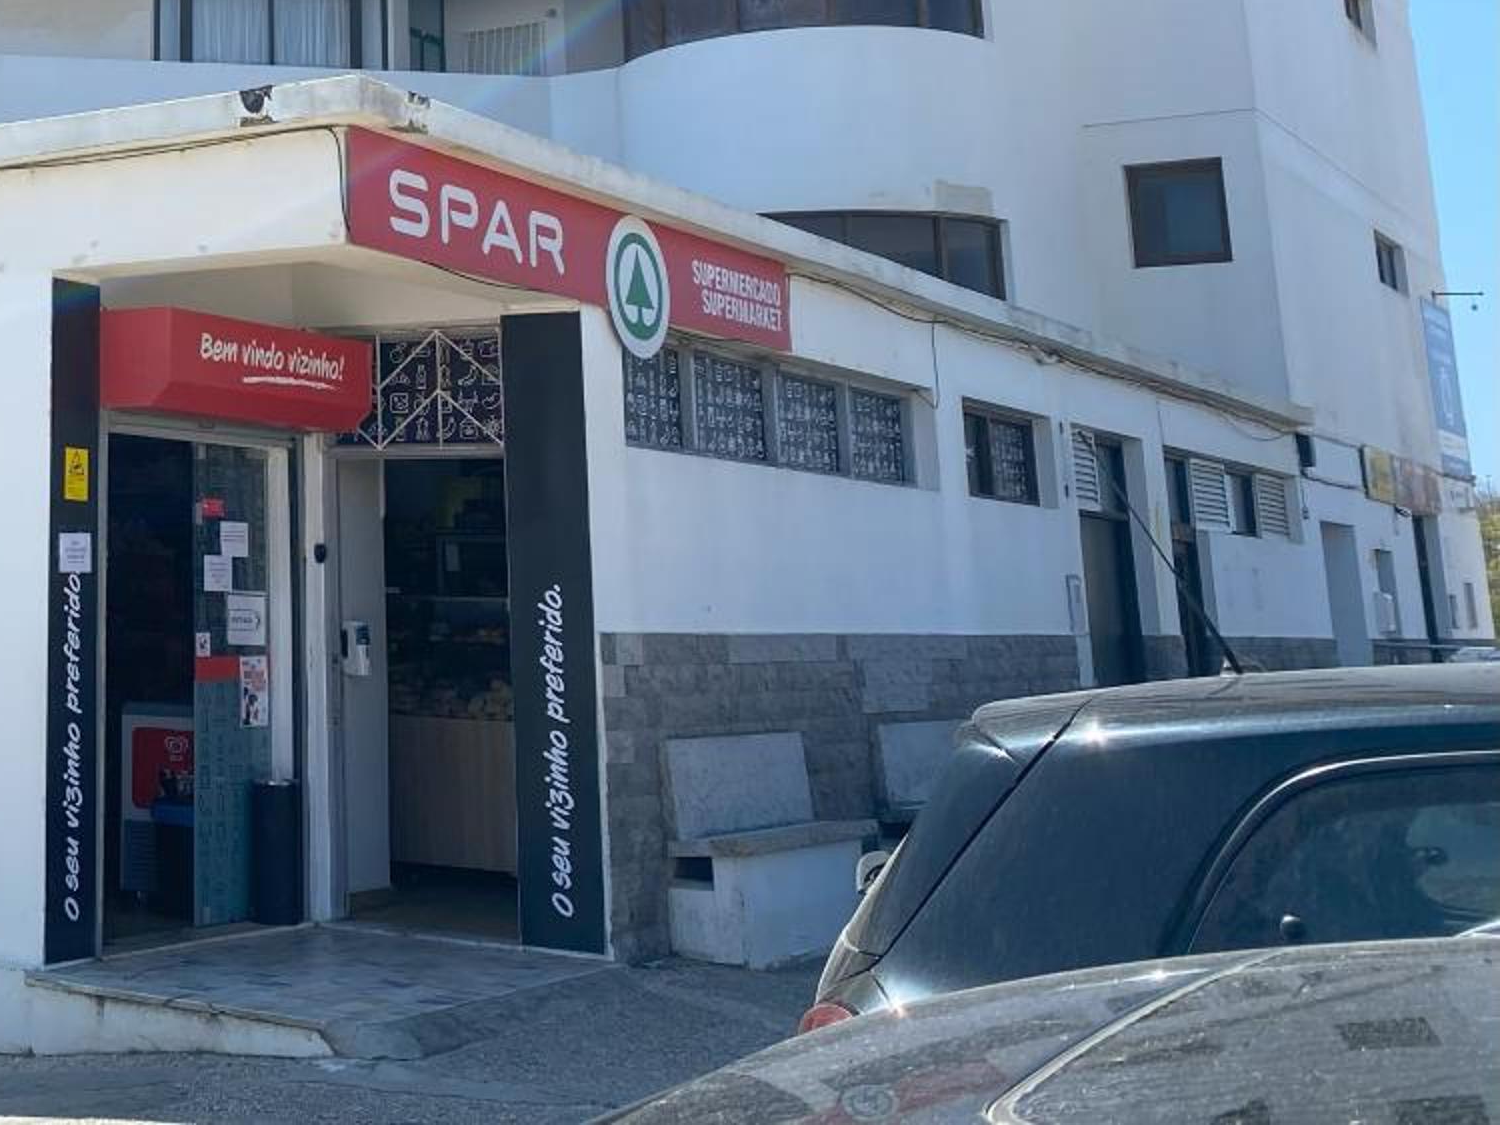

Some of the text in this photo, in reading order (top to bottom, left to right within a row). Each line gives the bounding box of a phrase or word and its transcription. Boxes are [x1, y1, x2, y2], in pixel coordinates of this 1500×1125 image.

[388, 168, 565, 275] SPAR
[691, 259, 781, 307] SUPERMERCADO
[701, 288, 782, 332] SUPERMARKET
[200, 333, 345, 381] Bem vindo vizinho!
[62, 722, 83, 828] vizinho
[537, 584, 575, 917] O seu vizinho preferido.
[65, 836, 80, 892] seu
[64, 896, 80, 922] O
